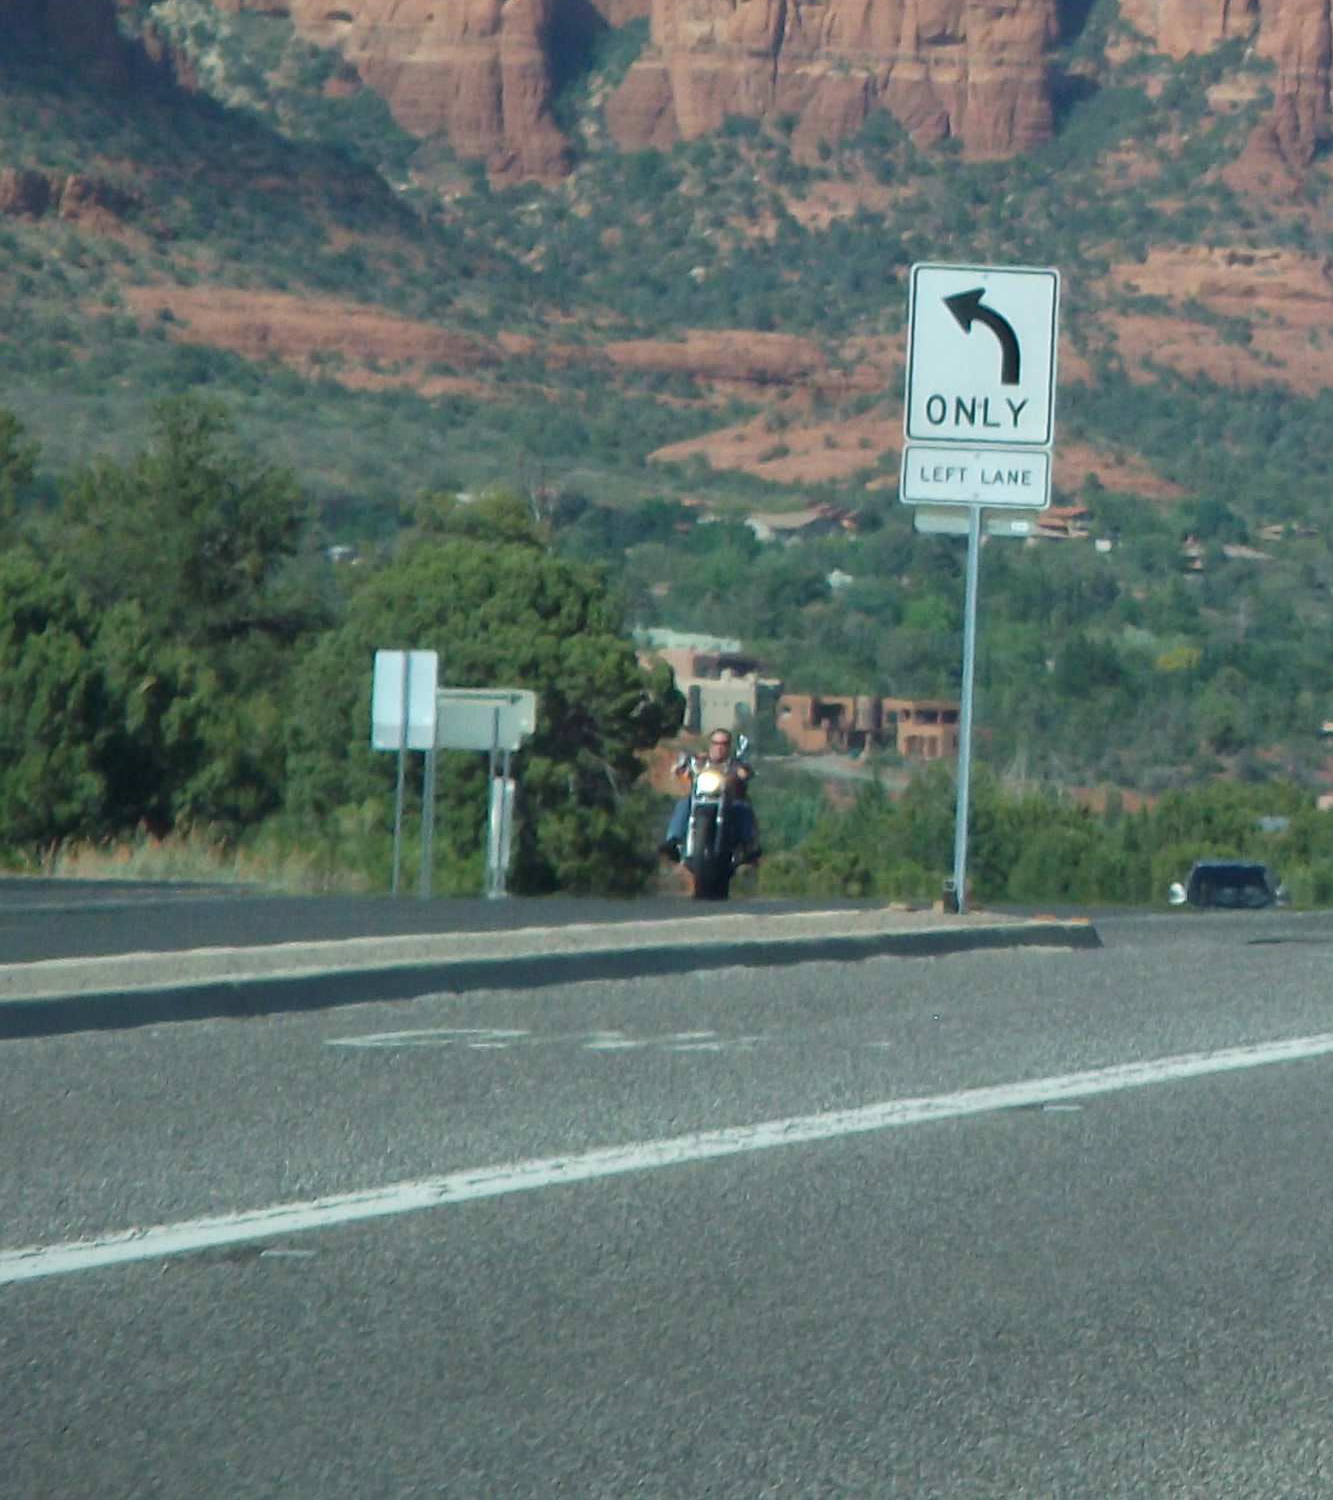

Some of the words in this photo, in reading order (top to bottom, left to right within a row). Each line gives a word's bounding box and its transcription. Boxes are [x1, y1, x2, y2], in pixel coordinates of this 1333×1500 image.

[926, 393, 1028, 429] ONLY
[920, 466, 968, 483] LEFT
[980, 468, 1032, 487] LANE
